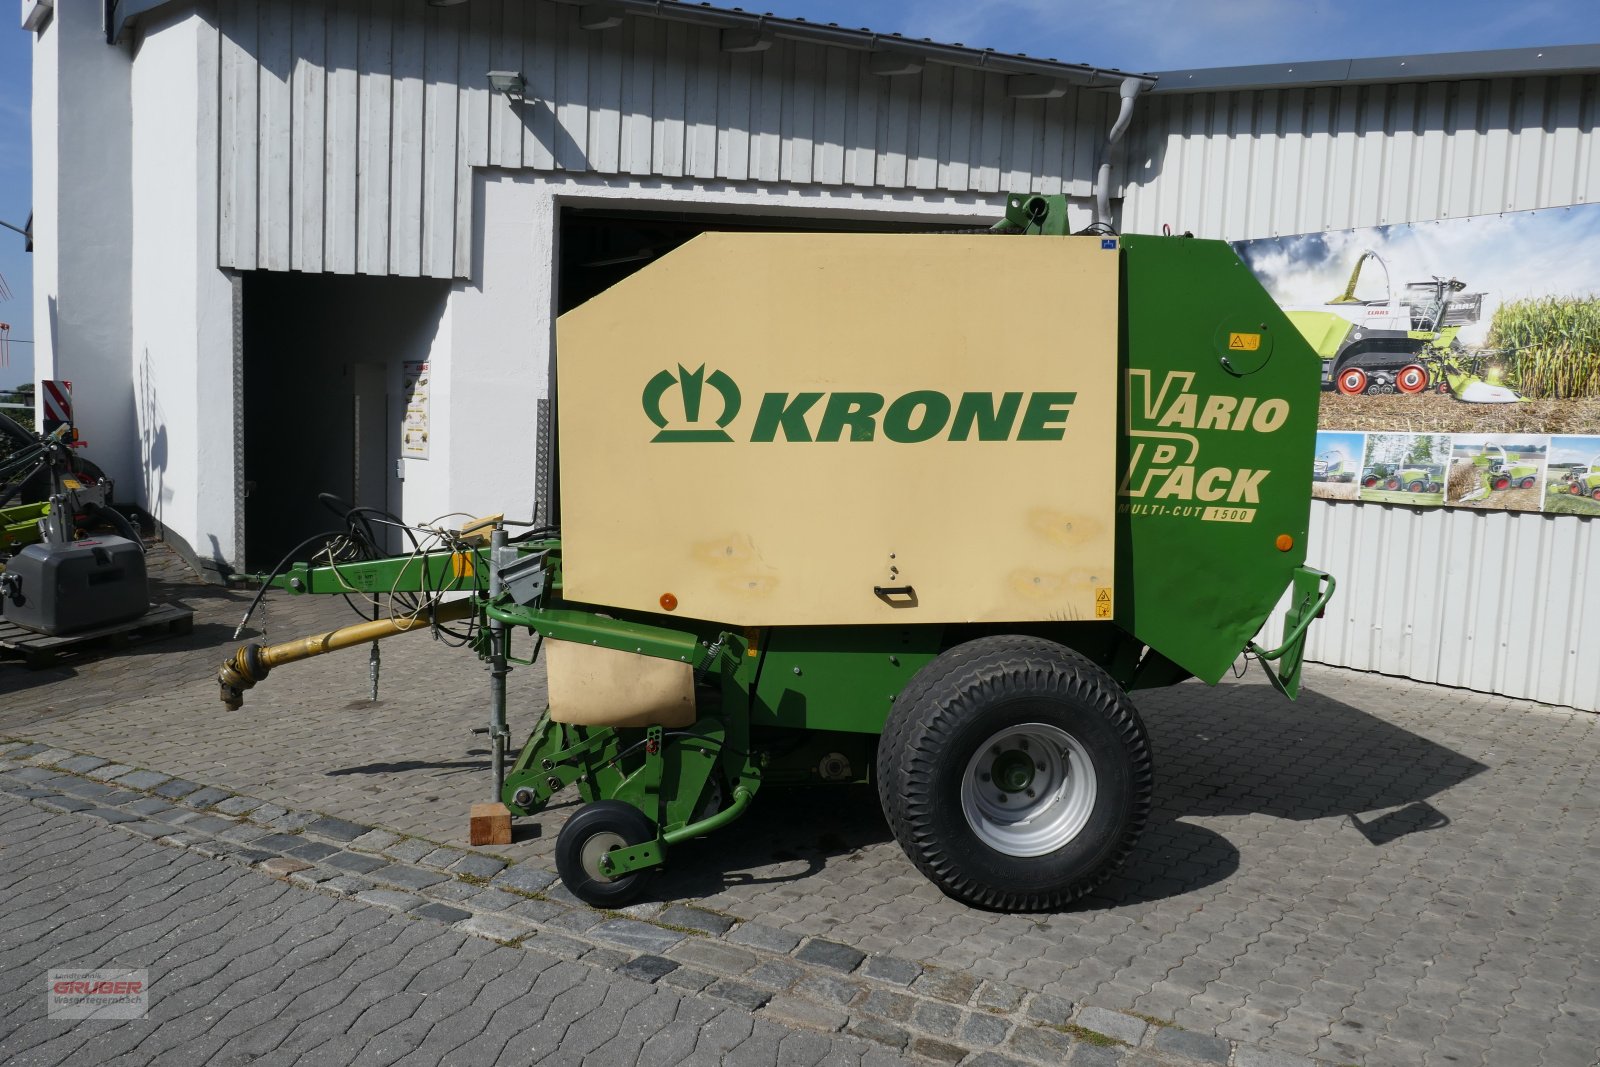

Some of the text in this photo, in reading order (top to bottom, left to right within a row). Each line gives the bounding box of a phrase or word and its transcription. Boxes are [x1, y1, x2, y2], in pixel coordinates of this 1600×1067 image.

[749, 390, 1078, 444] KRONE
[1125, 368, 1290, 433] VARIO
[1118, 430, 1271, 504] PACK
[1118, 504, 1248, 521] MULTI-CUT 1500
